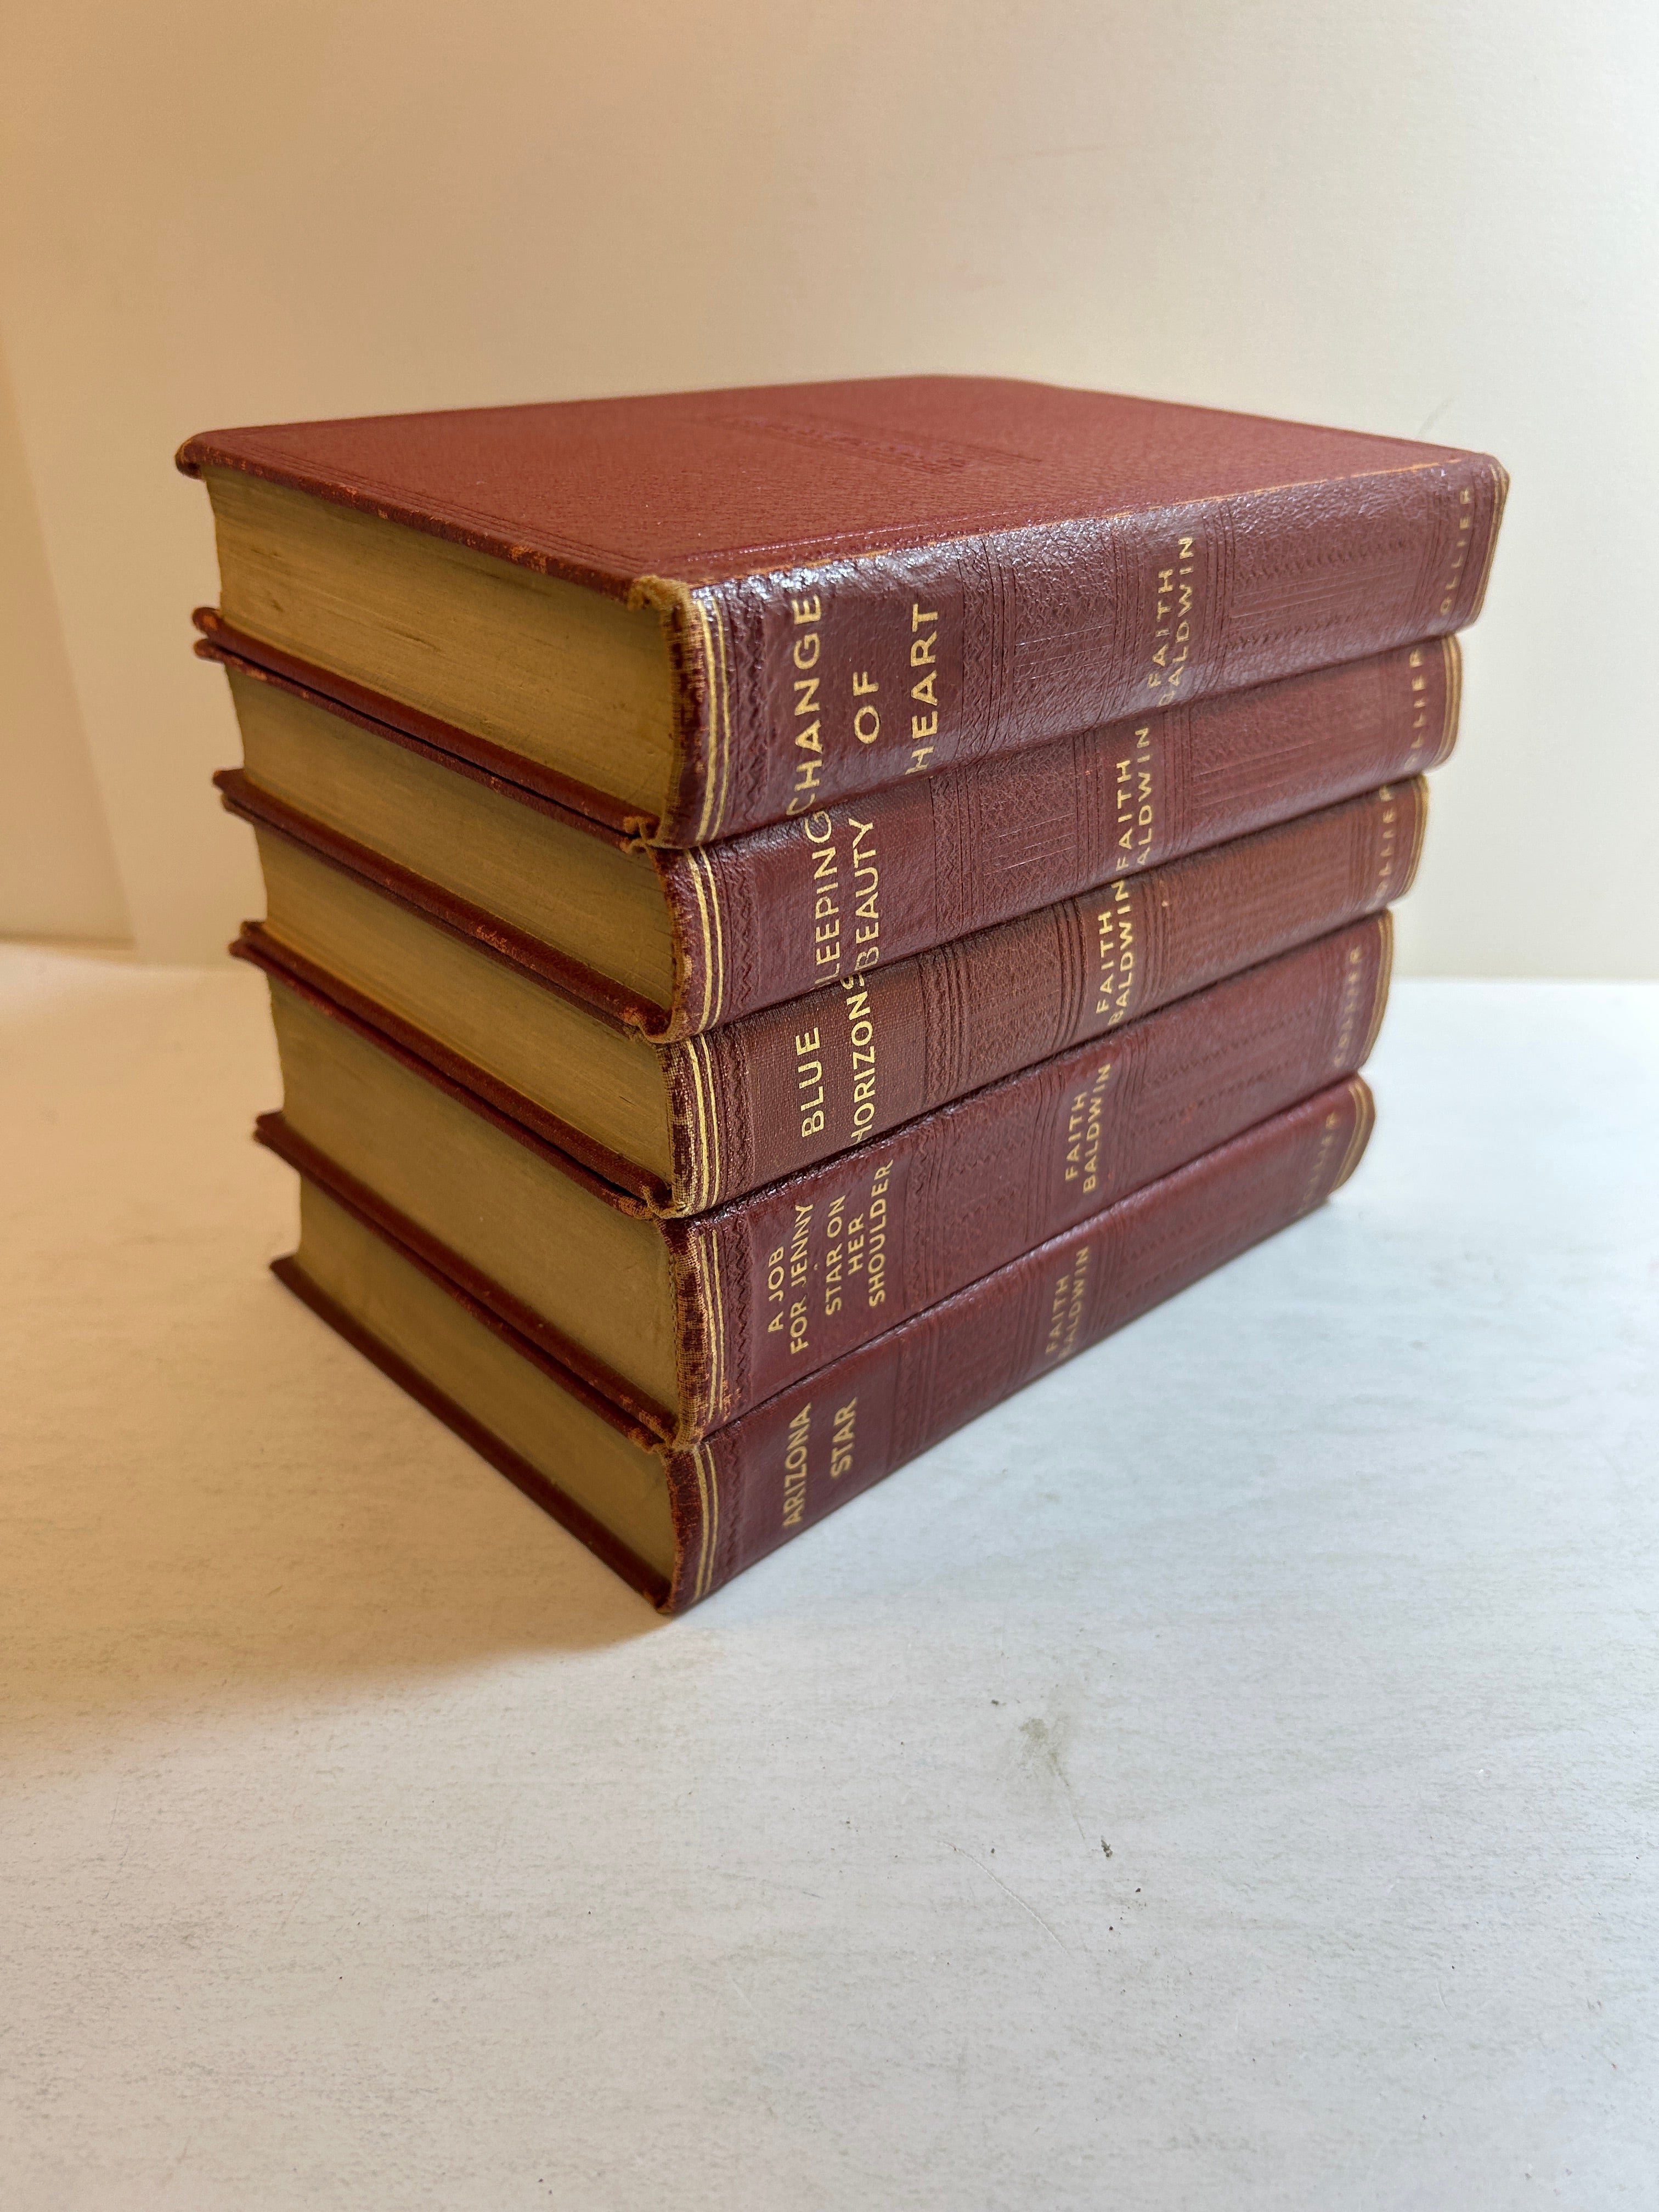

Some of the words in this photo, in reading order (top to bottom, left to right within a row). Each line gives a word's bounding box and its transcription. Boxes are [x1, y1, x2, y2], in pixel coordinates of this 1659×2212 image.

[1440, 488, 1471, 615] OLLIER
[1148, 569, 1173, 689] FAITH
[786, 594, 822, 816] CHANGE
[853, 672, 881, 744] OF
[905, 603, 939, 775] HEART
[1404, 648, 1426, 770] OLLIER
[1115, 760, 1131, 872] FAITH
[1136, 728, 1153, 865] ALDWIN
[1372, 786, 1395, 902] OLLIER
[805, 810, 841, 990] LEEPING
[849, 818, 879, 970] BEAUTY
[1096, 911, 1114, 1014] FAITH
[1107, 879, 1133, 1026] BALDWIN
[796, 1027, 824, 1138] BLUE
[1065, 1091, 1085, 1181] FAITH
[1083, 1063, 1111, 1193] BALDWIN
[791, 1204, 814, 1288] JENNY
[827, 1195, 845, 1238] ON
[848, 1212, 864, 1276] HER
[868, 1159, 894, 1308] SHOULDER
[768, 1246, 784, 1302] JOB
[768, 1311, 784, 1333] A
[790, 1294, 809, 1355] FOR
[826, 1243, 843, 1315] STAR
[1046, 1274, 1070, 1356] FAITH
[783, 1402, 812, 1528] ARIZONA
[831, 1397, 858, 1479] STAR
